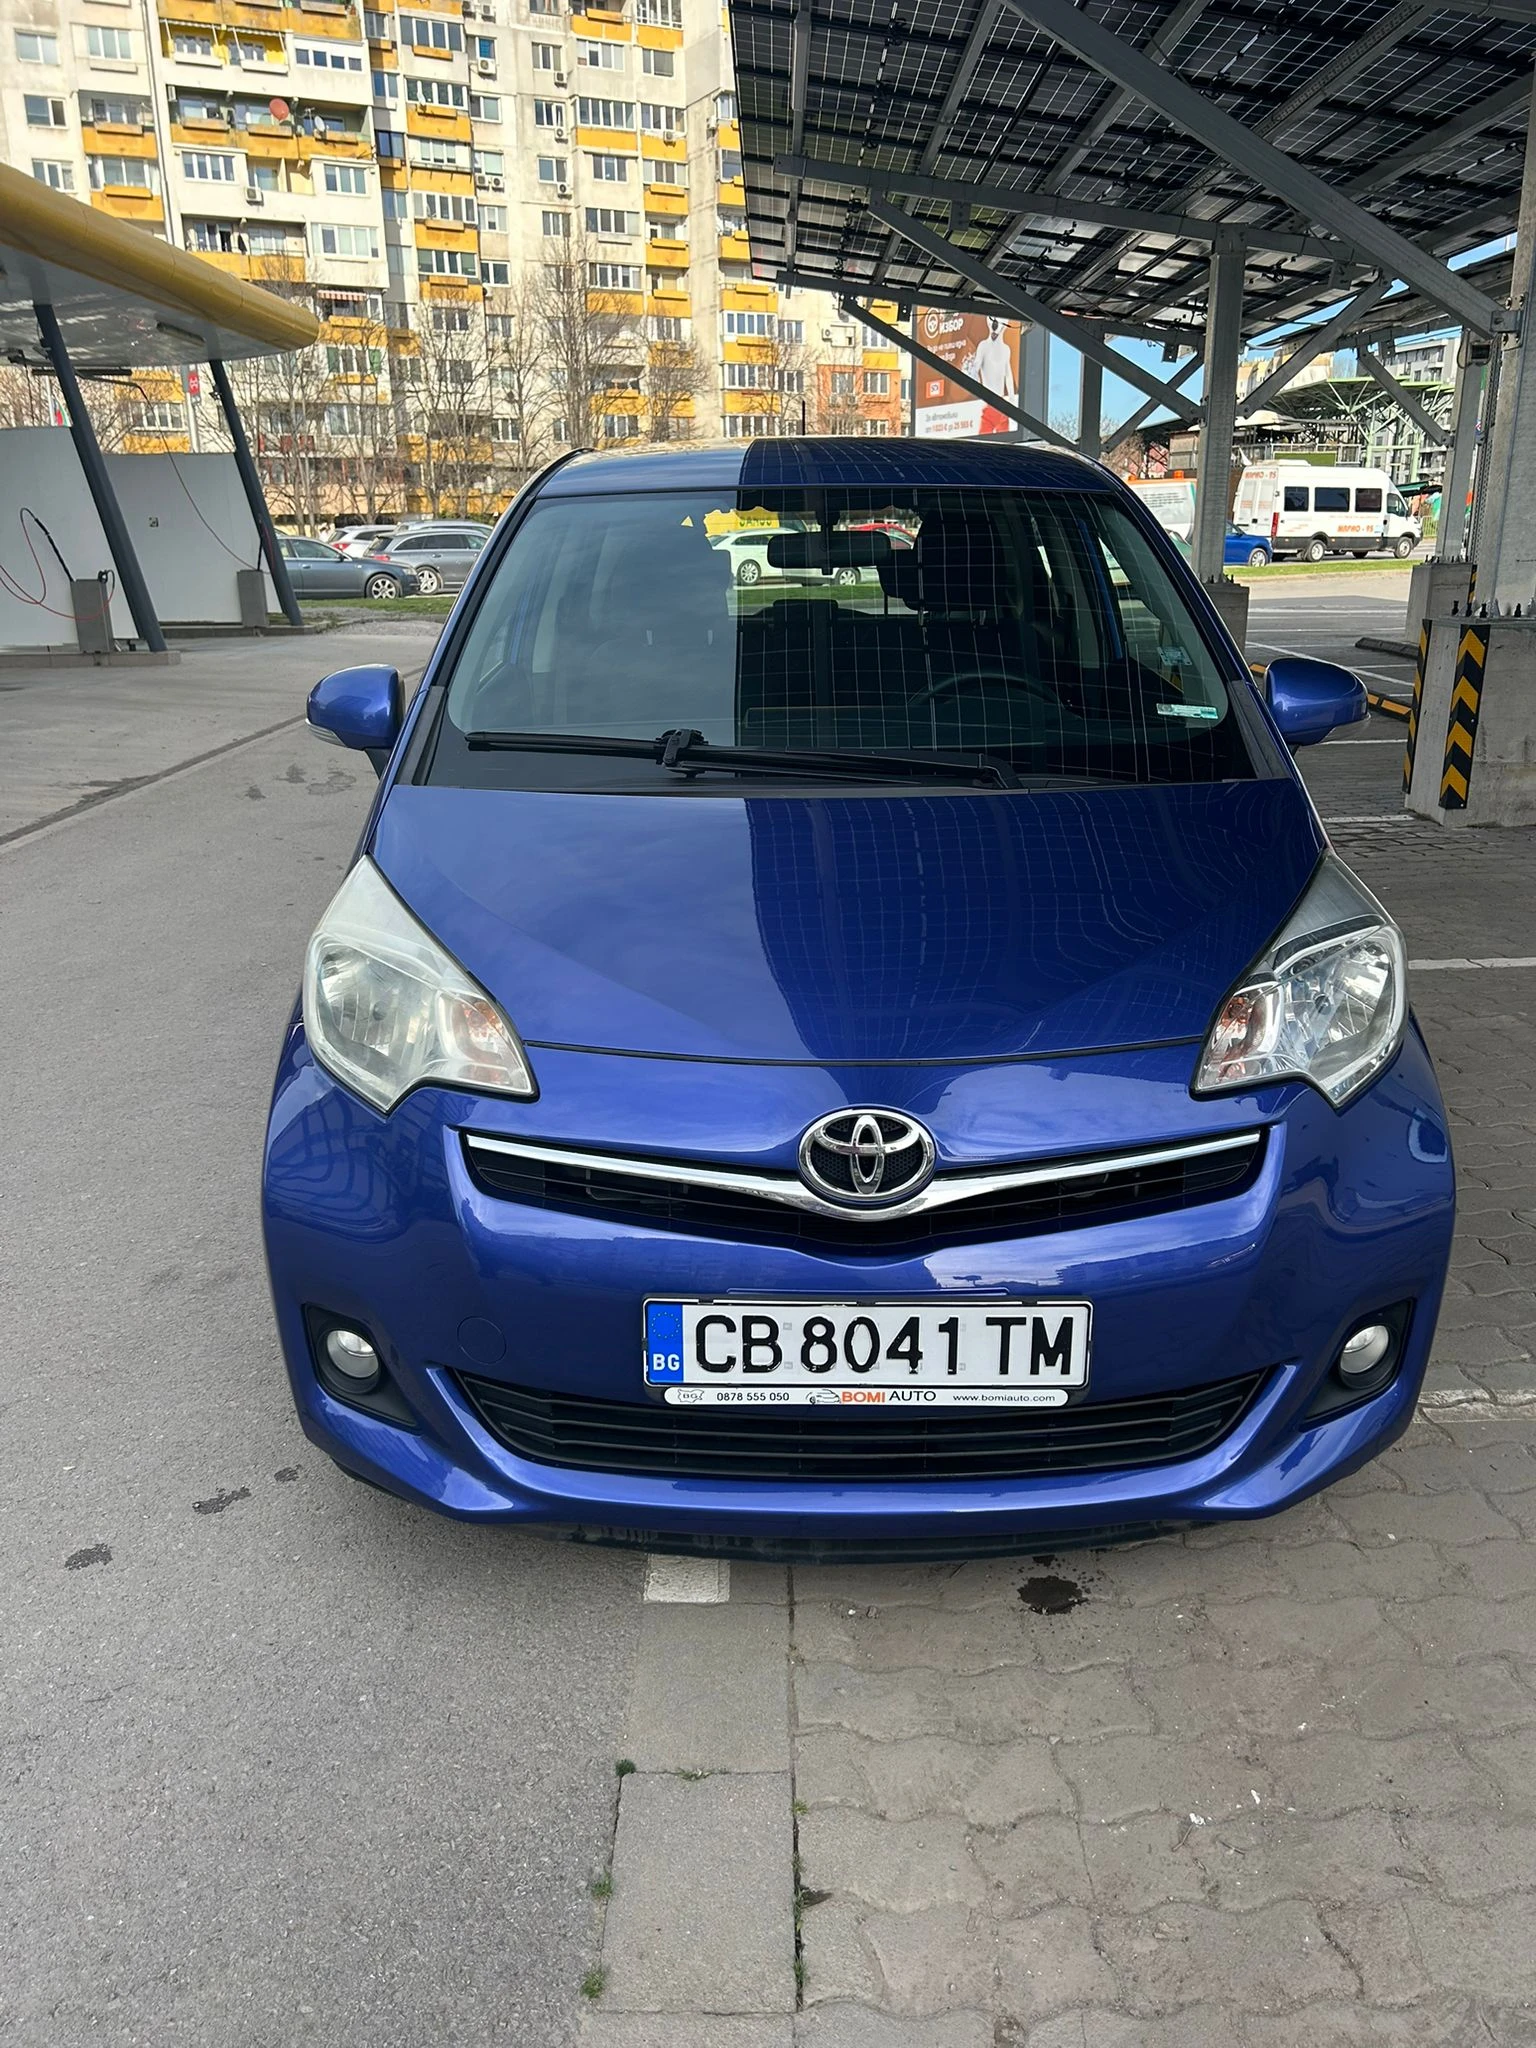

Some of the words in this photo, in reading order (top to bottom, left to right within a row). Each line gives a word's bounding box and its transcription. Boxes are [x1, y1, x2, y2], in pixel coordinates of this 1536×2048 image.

[939, 318, 964, 334] ИЗБОР
[696, 1315, 782, 1373] CB
[800, 1316, 959, 1374] 8041
[986, 1317, 1073, 1375] TM
[653, 1354, 680, 1371] BG
[716, 1392, 743, 1402] 0878
[746, 1392, 766, 1402] 555
[769, 1392, 790, 1402] 050
[841, 1391, 885, 1403] BOMI
[888, 1390, 937, 1402] AUTO
[952, 1393, 1056, 1402] www.bomiauto.com
